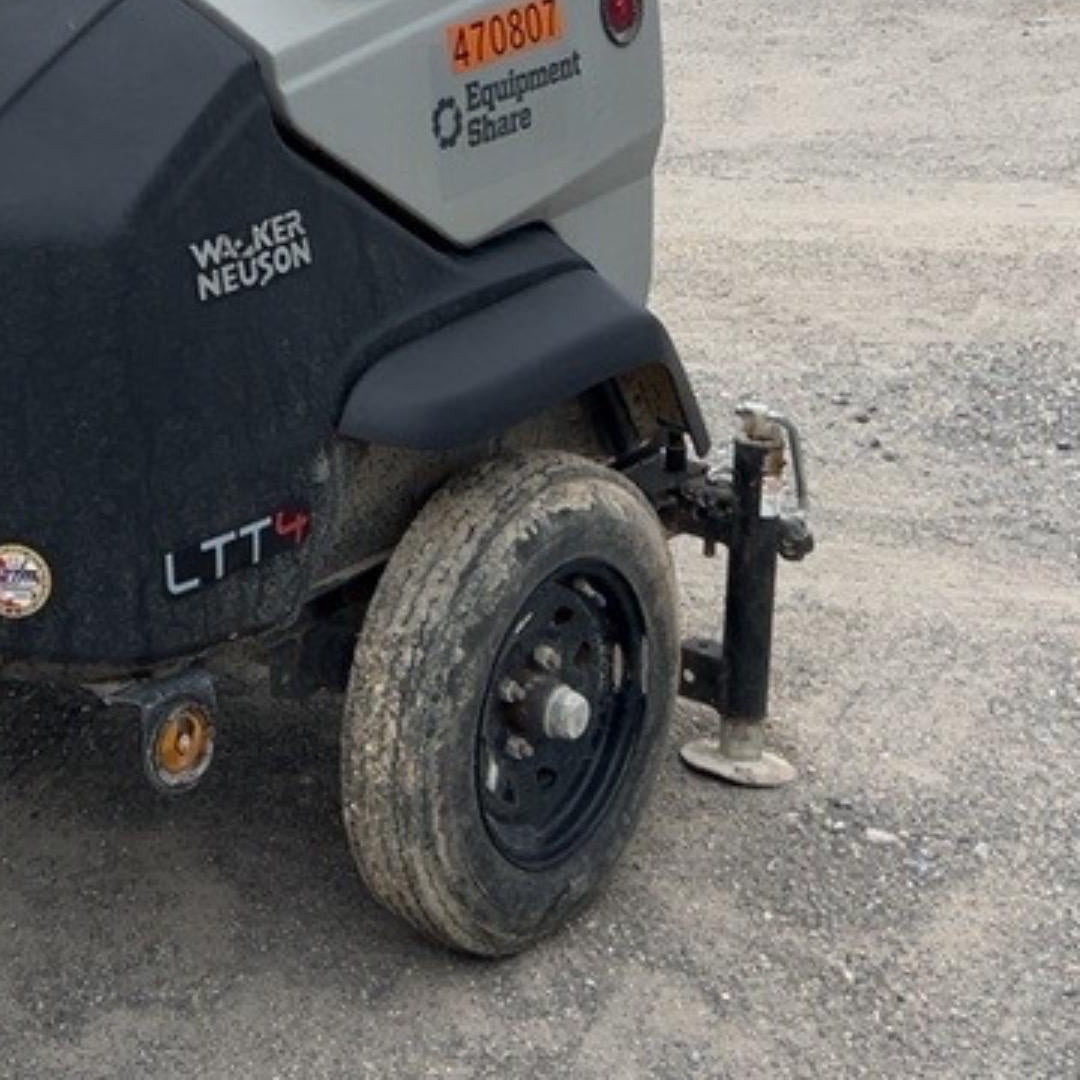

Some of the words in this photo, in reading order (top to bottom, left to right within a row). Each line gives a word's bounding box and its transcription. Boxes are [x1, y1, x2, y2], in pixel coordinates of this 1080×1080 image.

[465, 50, 581, 112] Equipment
[467, 107, 532, 148] Share
[197, 236, 312, 301] NEUSON
